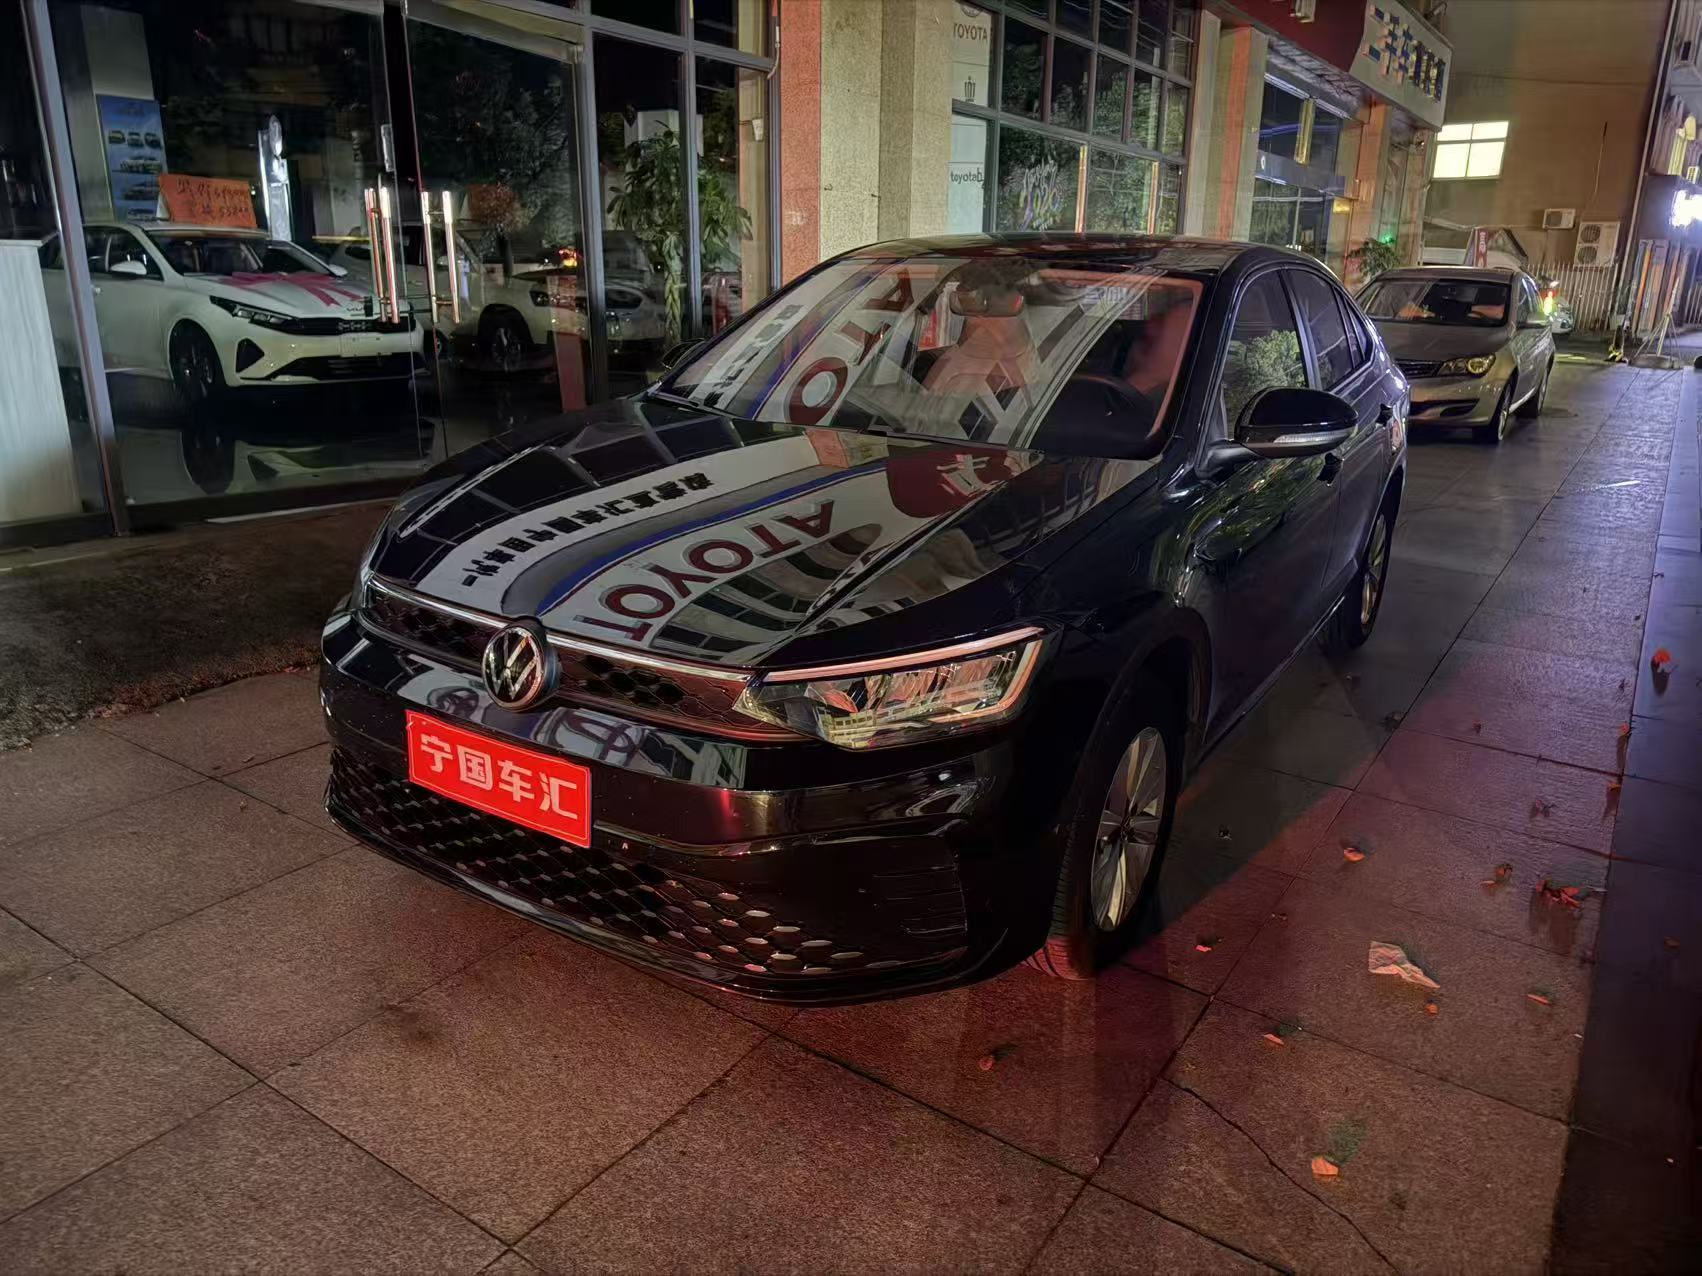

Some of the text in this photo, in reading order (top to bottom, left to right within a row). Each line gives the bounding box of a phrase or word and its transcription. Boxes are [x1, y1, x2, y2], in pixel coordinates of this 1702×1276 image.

[953, 23, 988, 41] TOYOTA
[420, 733, 579, 820] 宁国车汇
